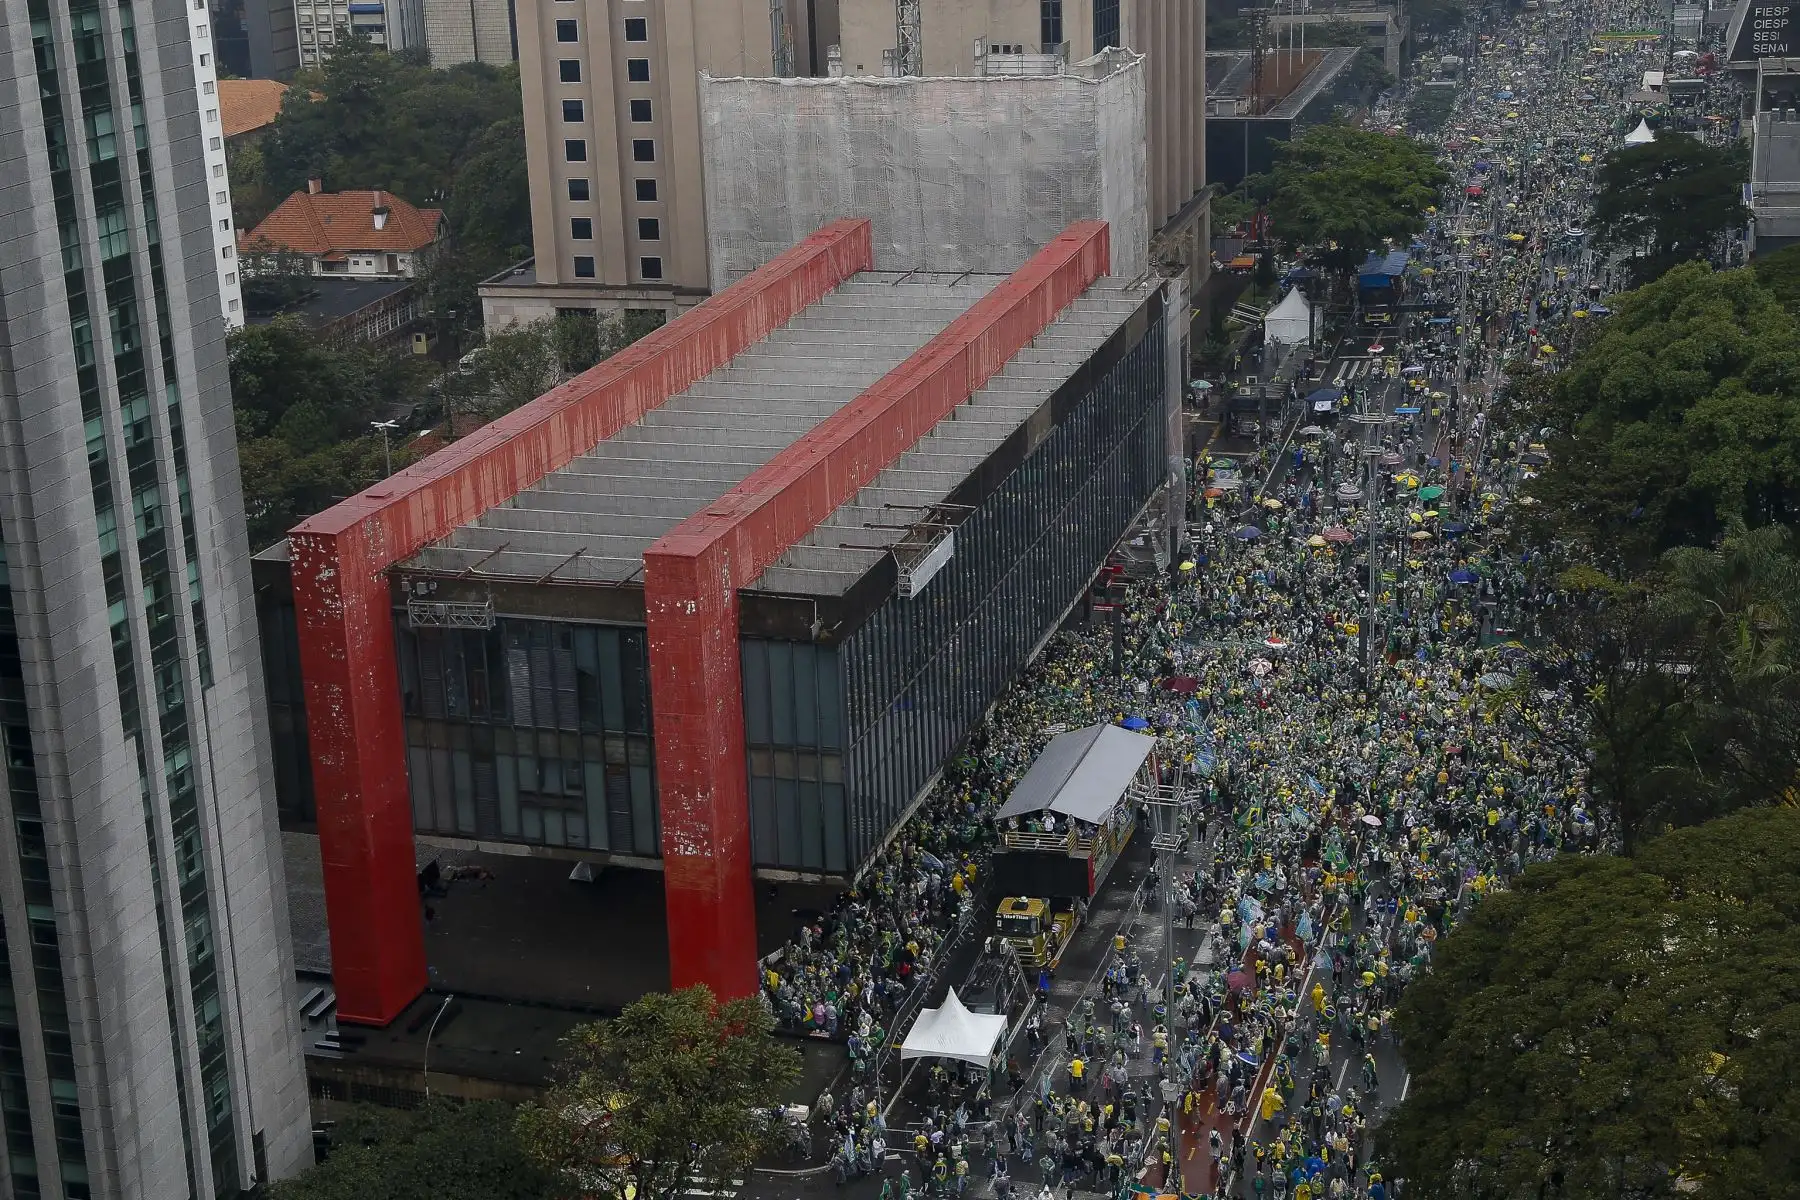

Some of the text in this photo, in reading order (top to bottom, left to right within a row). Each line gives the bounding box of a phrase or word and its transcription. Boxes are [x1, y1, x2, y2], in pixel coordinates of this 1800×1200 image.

[1755, 6, 1790, 17] FIESP
[1753, 19, 1789, 29] CIESP
[1753, 31, 1780, 41] SESI
[1753, 43, 1788, 53] SENAI
